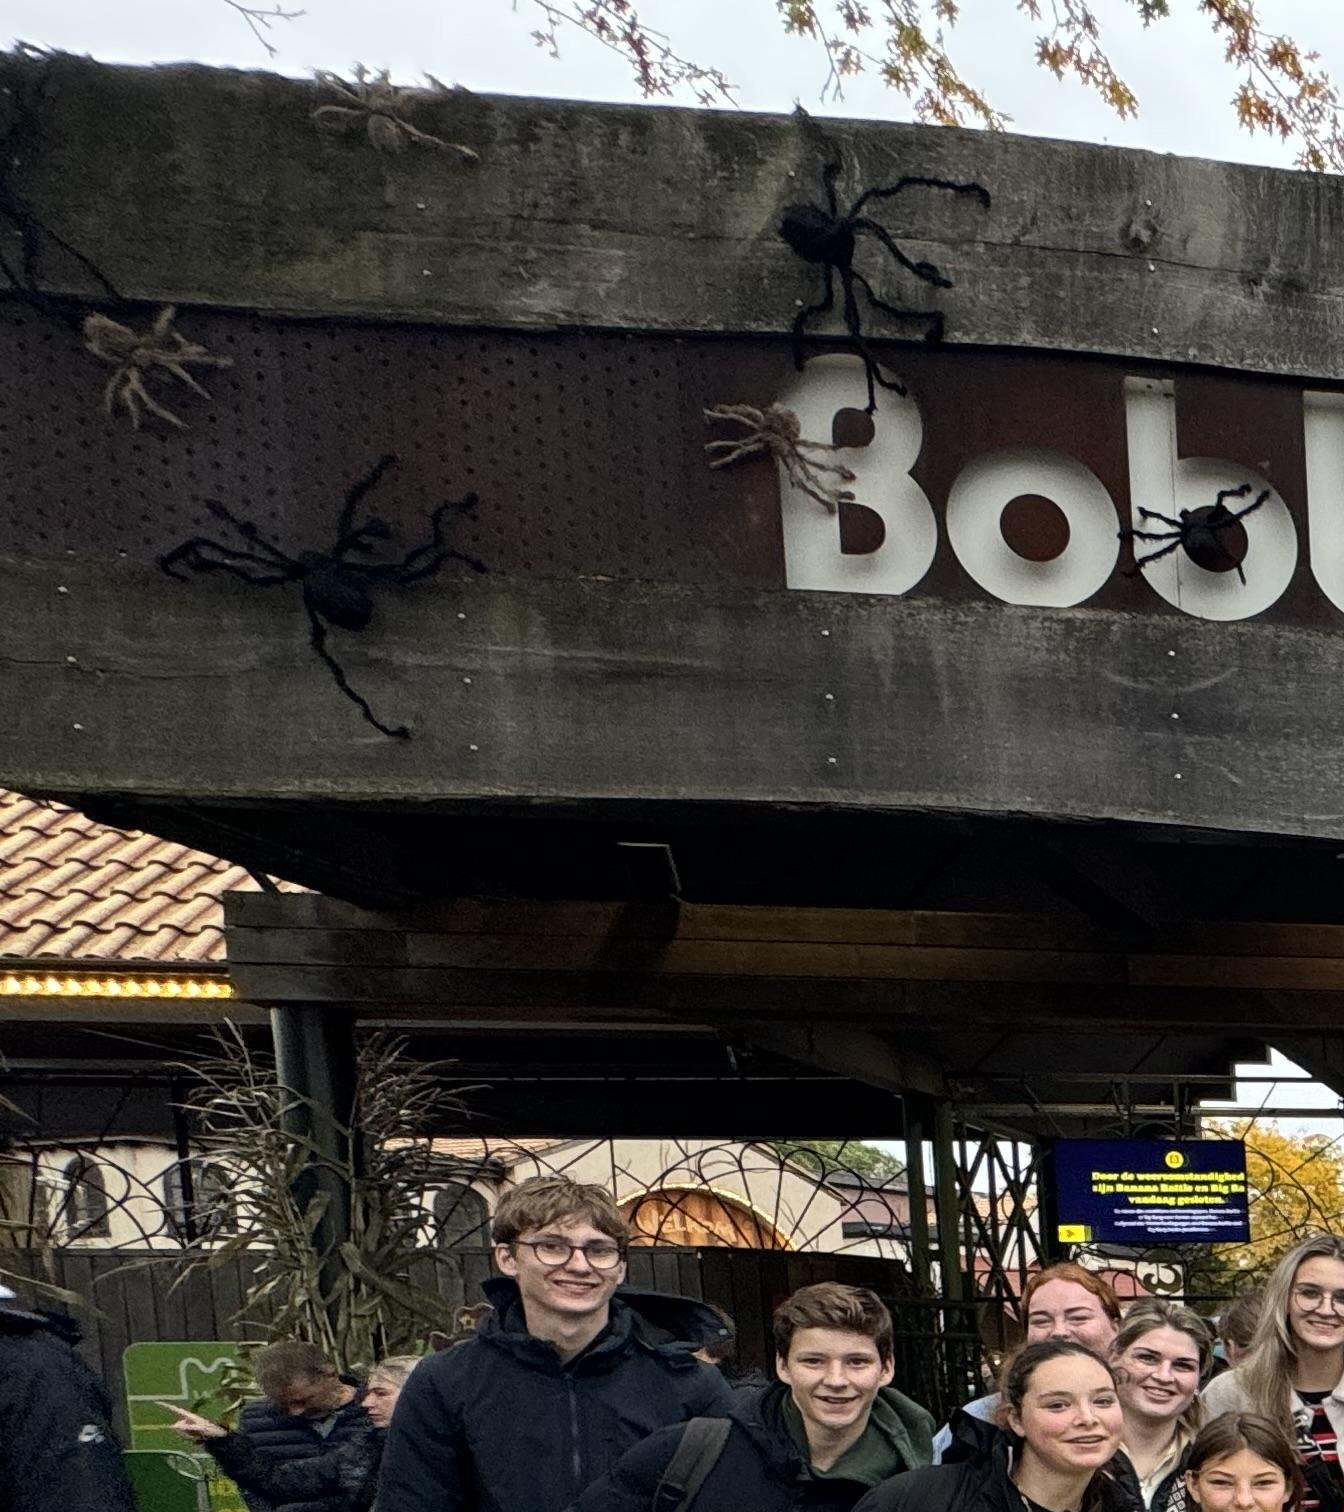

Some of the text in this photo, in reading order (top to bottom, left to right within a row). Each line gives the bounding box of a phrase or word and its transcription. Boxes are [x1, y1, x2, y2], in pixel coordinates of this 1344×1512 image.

[1091, 1172, 1119, 1181] Door
[1120, 1172, 1135, 1180] de
[1092, 1184, 1114, 1194] zijn
[1116, 1184, 1159, 1192] Banana
[1211, 1184, 1229, 1194] Big
[1128, 1196, 1226, 1206] vandaag gesloten.
